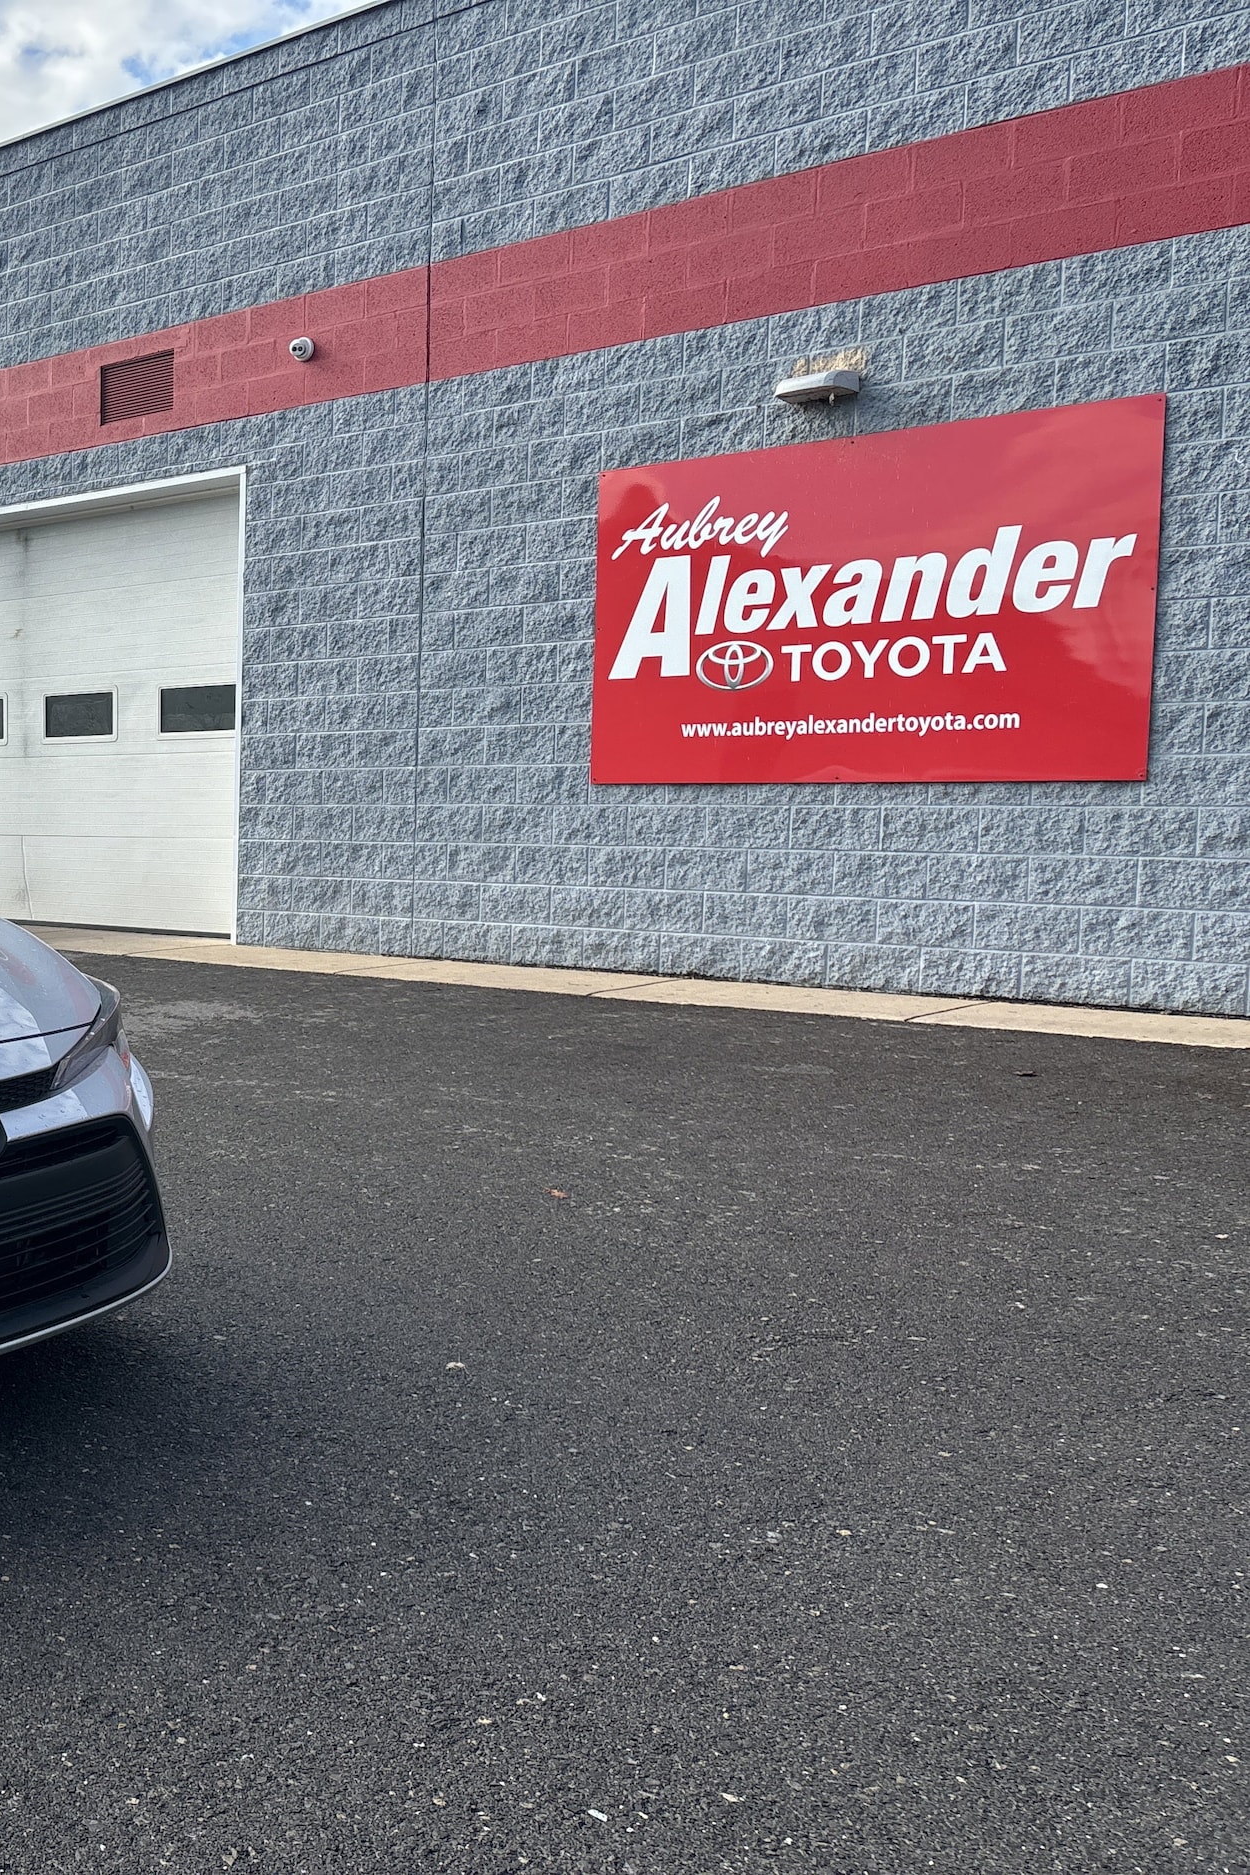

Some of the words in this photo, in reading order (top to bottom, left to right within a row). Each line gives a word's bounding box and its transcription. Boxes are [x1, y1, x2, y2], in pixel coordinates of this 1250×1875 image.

[611, 495, 789, 560] Aubrey
[608, 524, 1138, 680] Alexander
[780, 632, 1007, 682] TOYOTA
[681, 711, 1021, 740] www.aubreyalexandertoyota.com
